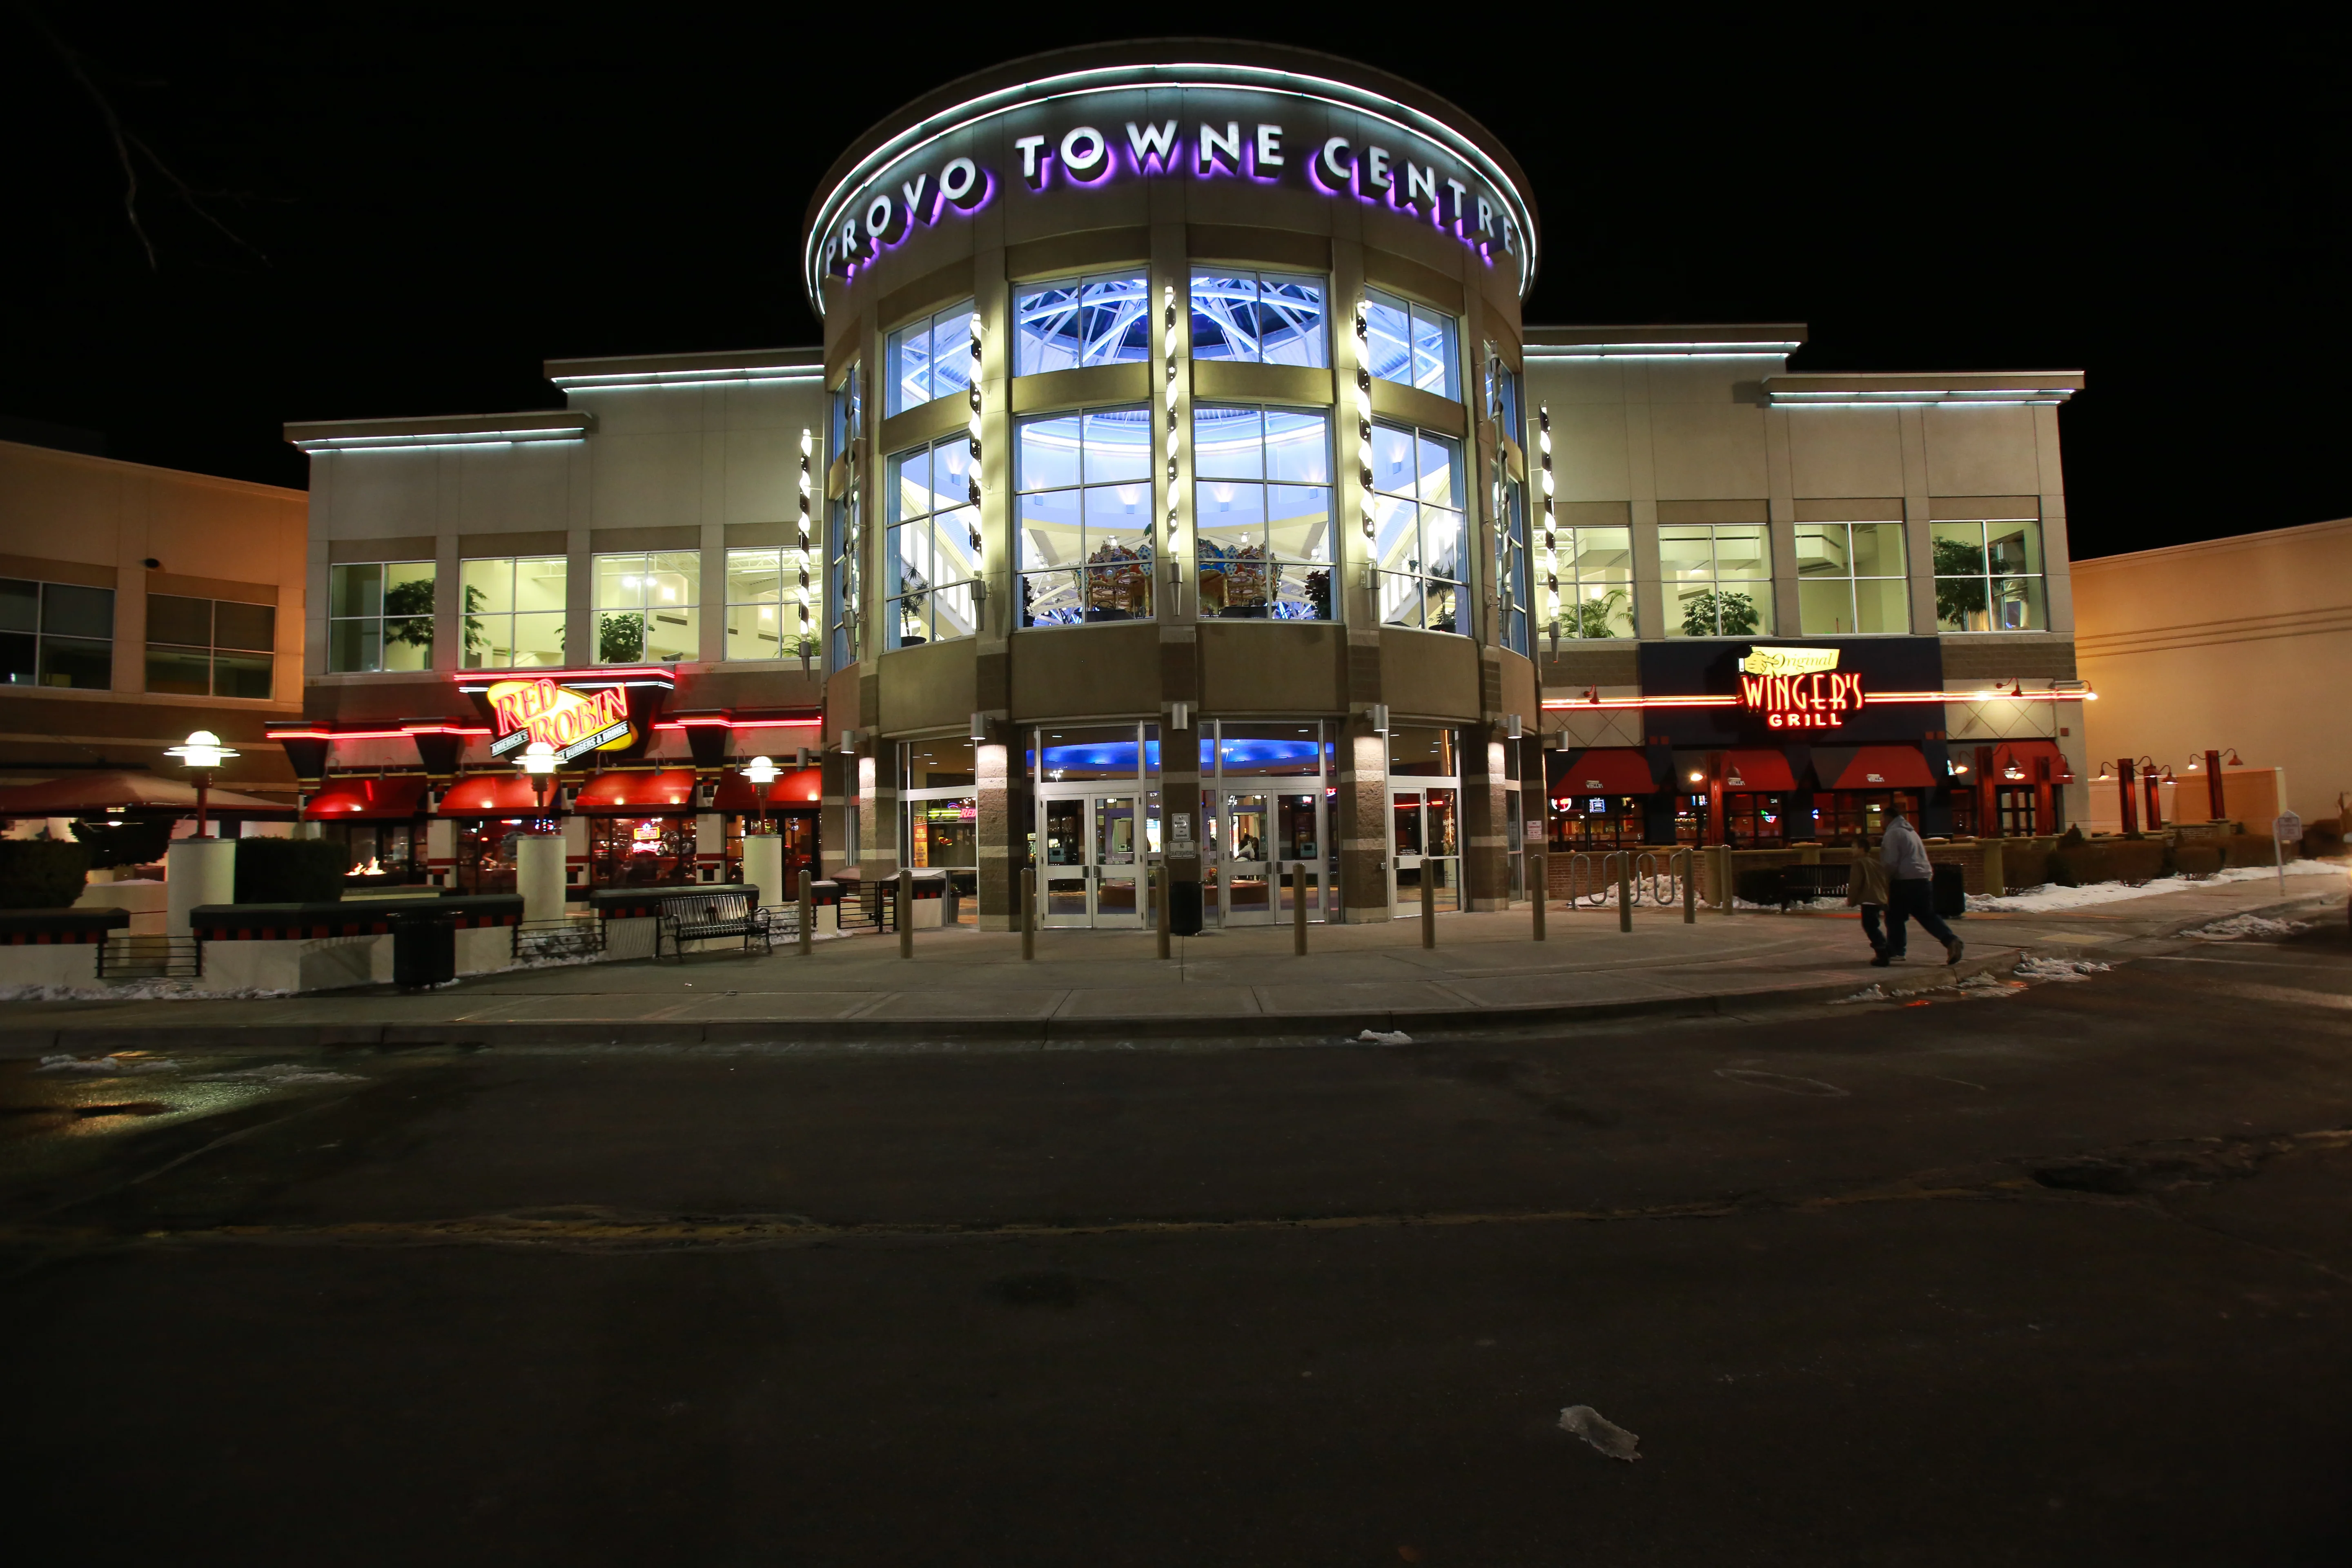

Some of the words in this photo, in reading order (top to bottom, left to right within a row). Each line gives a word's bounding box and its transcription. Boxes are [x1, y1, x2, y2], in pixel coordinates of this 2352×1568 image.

[826, 157, 976, 278] PROVO
[1015, 120, 1285, 177] TOWNE
[1323, 136, 1514, 256] CENTRE
[1772, 653, 1833, 670] Original
[494, 678, 557, 736] RED
[1742, 673, 1863, 711] WINGER'S
[528, 683, 628, 750] ROBIN
[1769, 713, 1842, 727] GRILL
[492, 730, 528, 755] AMERICA'S
[566, 738, 596, 758] BURGERS
[596, 735, 603, 744] &
[602, 723, 628, 741] DRINKS
